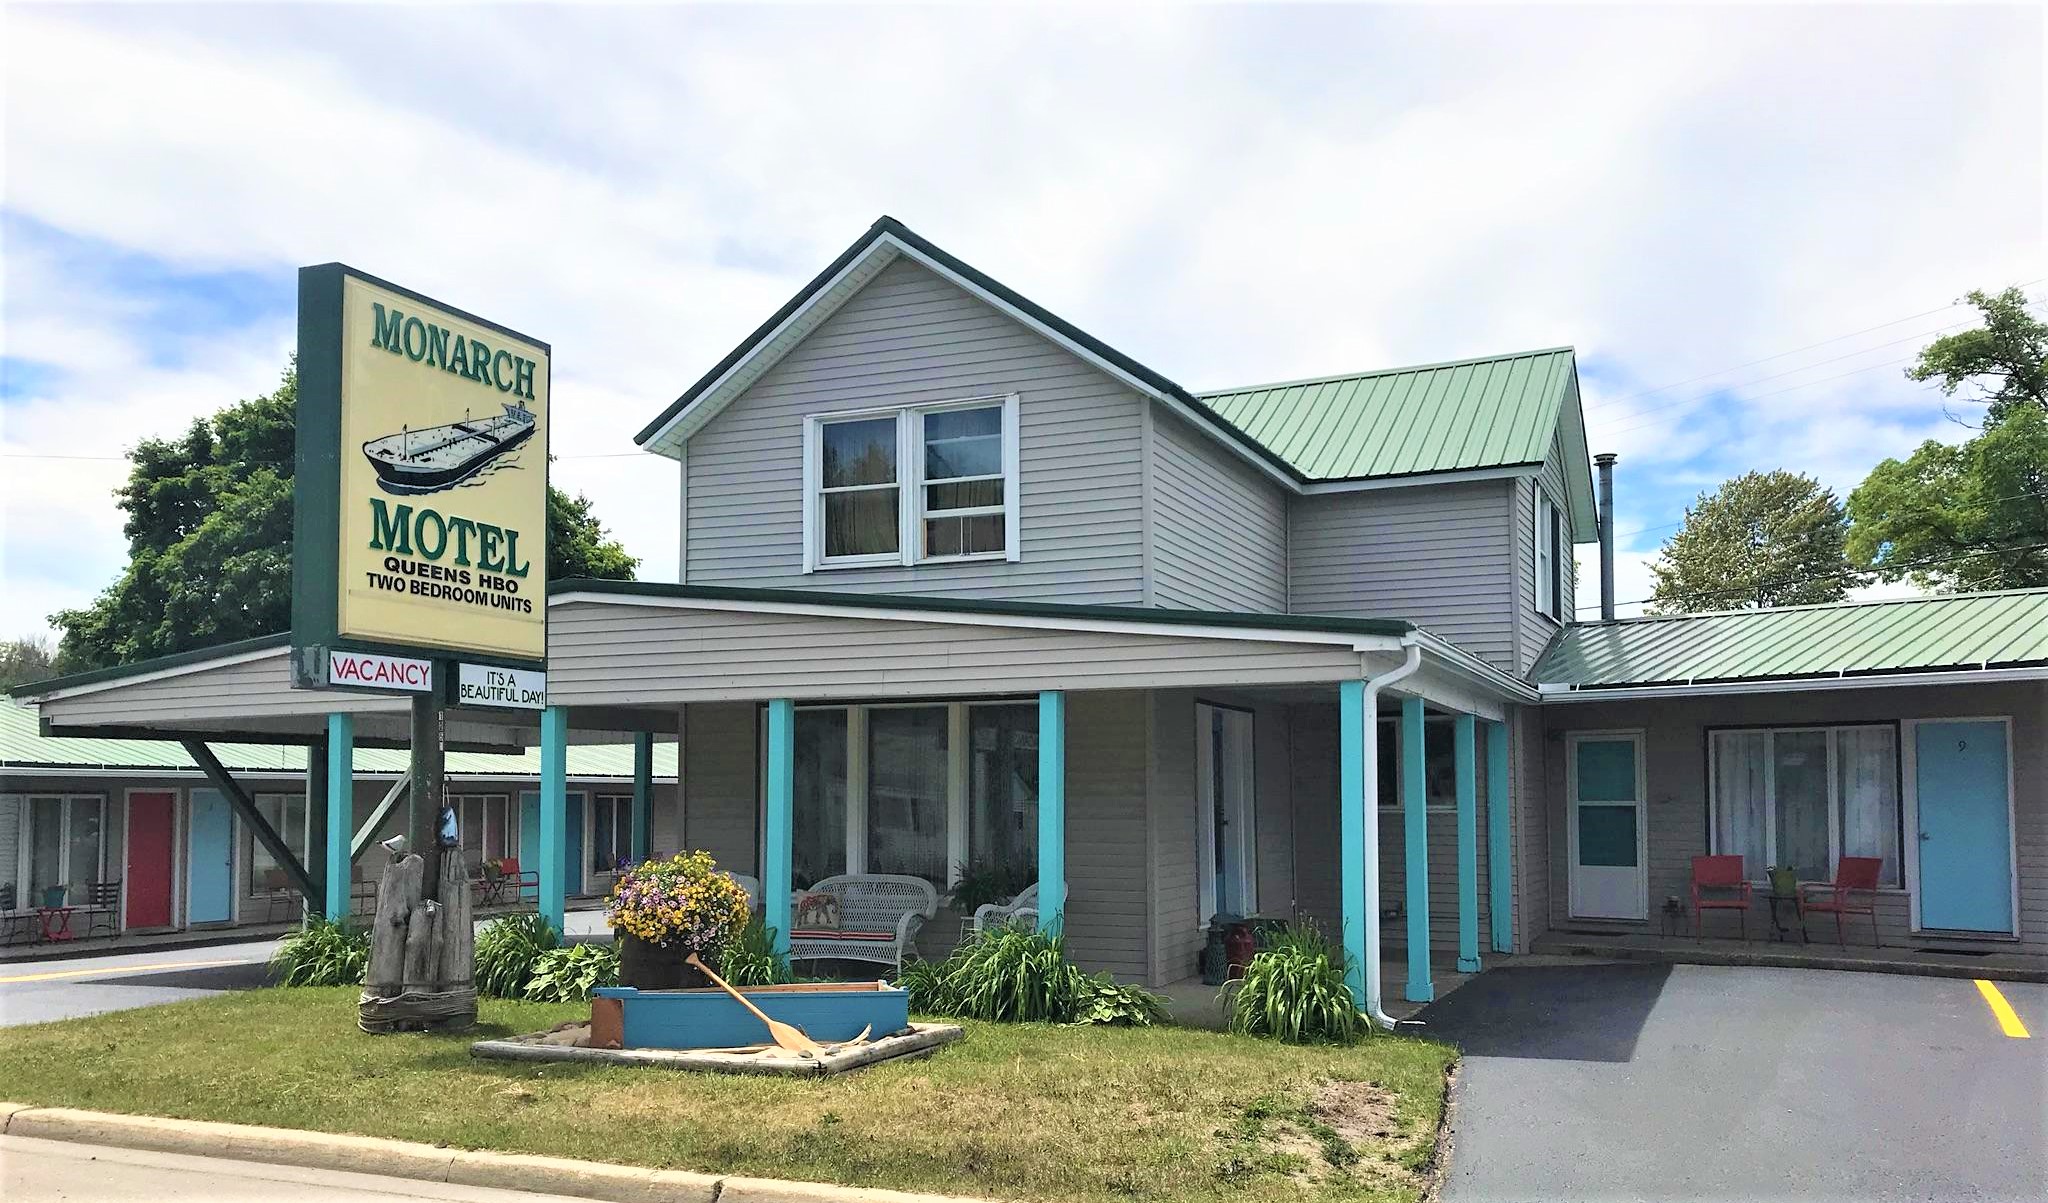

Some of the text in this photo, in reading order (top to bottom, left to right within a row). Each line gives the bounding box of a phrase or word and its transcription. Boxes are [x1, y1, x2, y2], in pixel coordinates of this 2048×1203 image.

[371, 302, 536, 401] MONARCH
[369, 497, 530, 578] MOTEL
[384, 556, 519, 594] QUEENS HBO
[366, 572, 532, 614] TWO BEDROOM UNITS
[332, 656, 430, 686] VACANCY
[487, 671, 516, 687] IT'S A
[461, 684, 544, 705] BEAUTIFUL DAY!
[1958, 740, 1967, 752] 9
